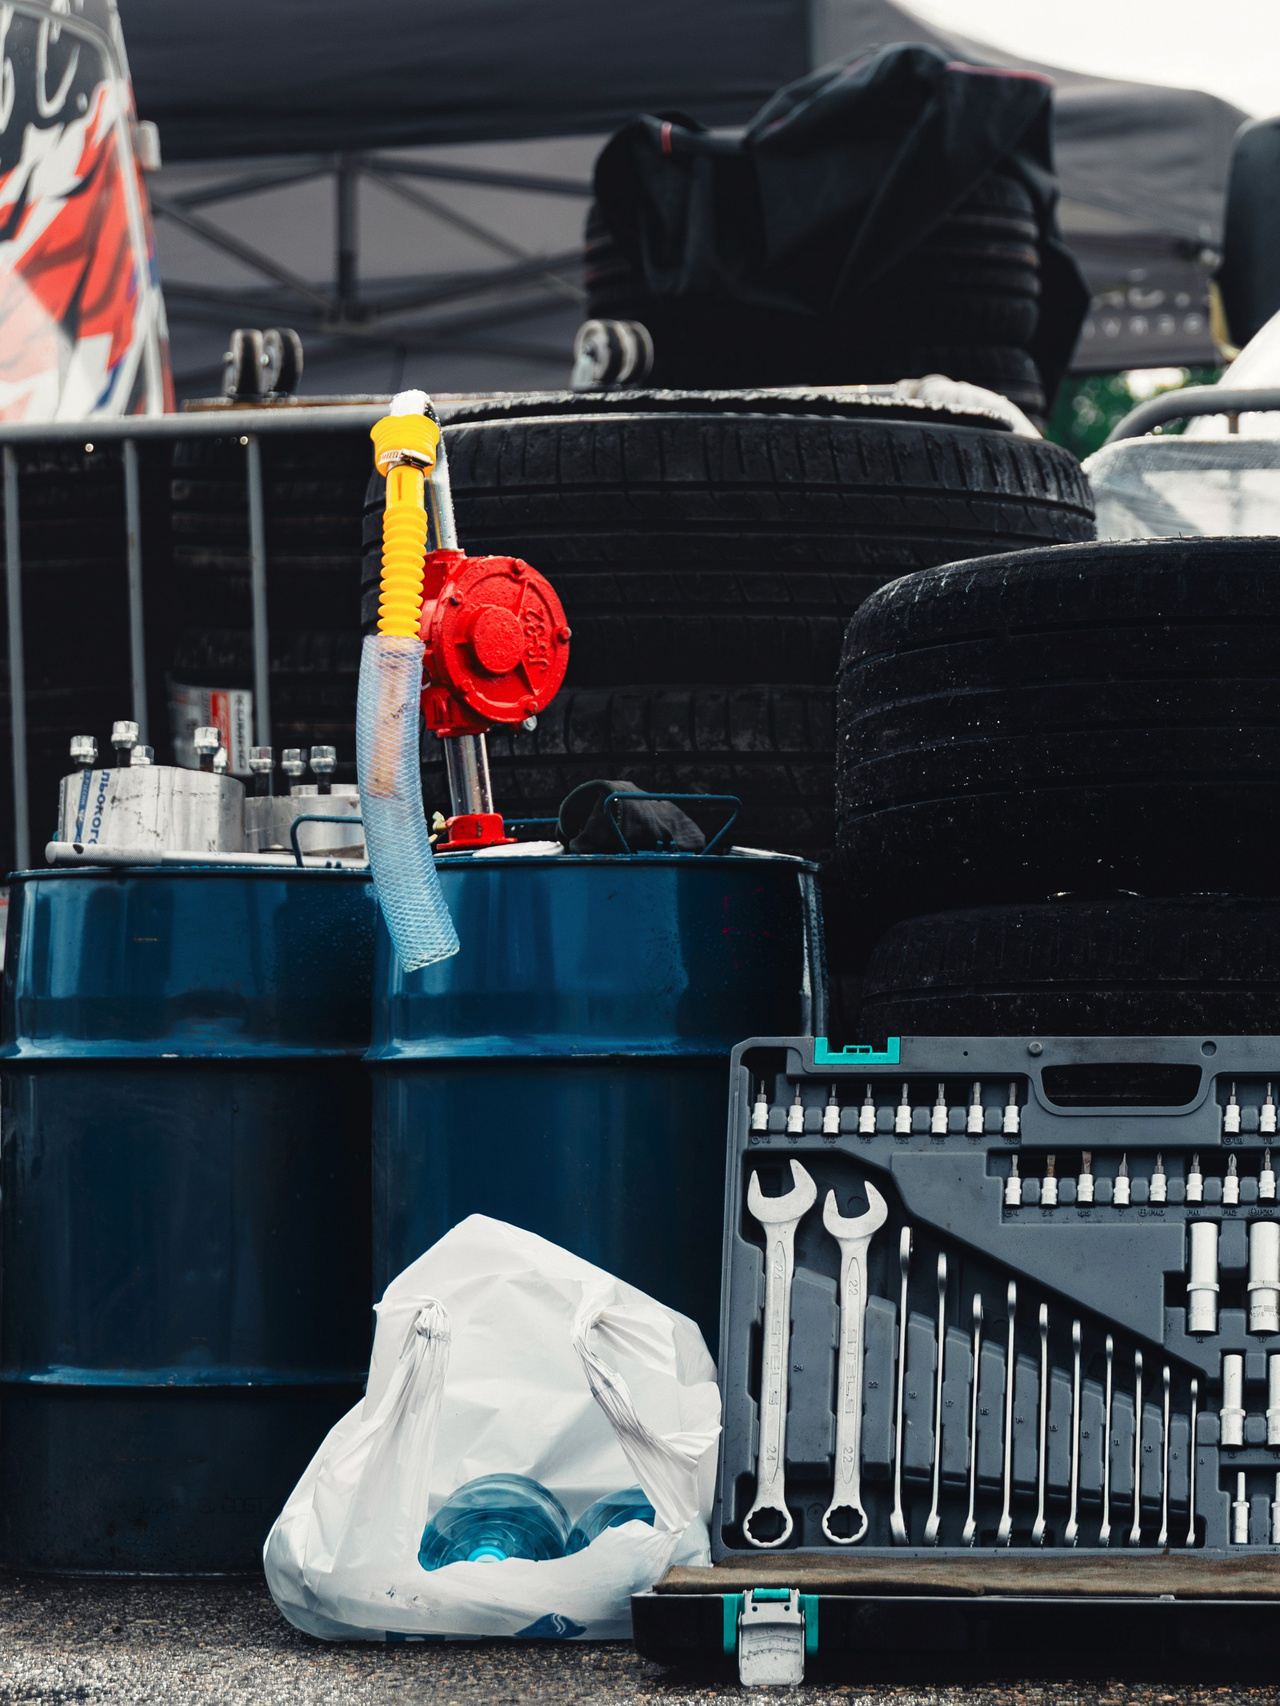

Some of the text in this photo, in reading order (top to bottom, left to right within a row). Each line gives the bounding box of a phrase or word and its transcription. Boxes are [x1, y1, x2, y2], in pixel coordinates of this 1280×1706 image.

[524, 607, 550, 672] JS-32
[848, 1279, 859, 1296] 22
[768, 1318, 782, 1405] STELS
[844, 1329, 858, 1414] STELS
[766, 1446, 777, 1461] 24
[843, 1447, 853, 1463] 22
